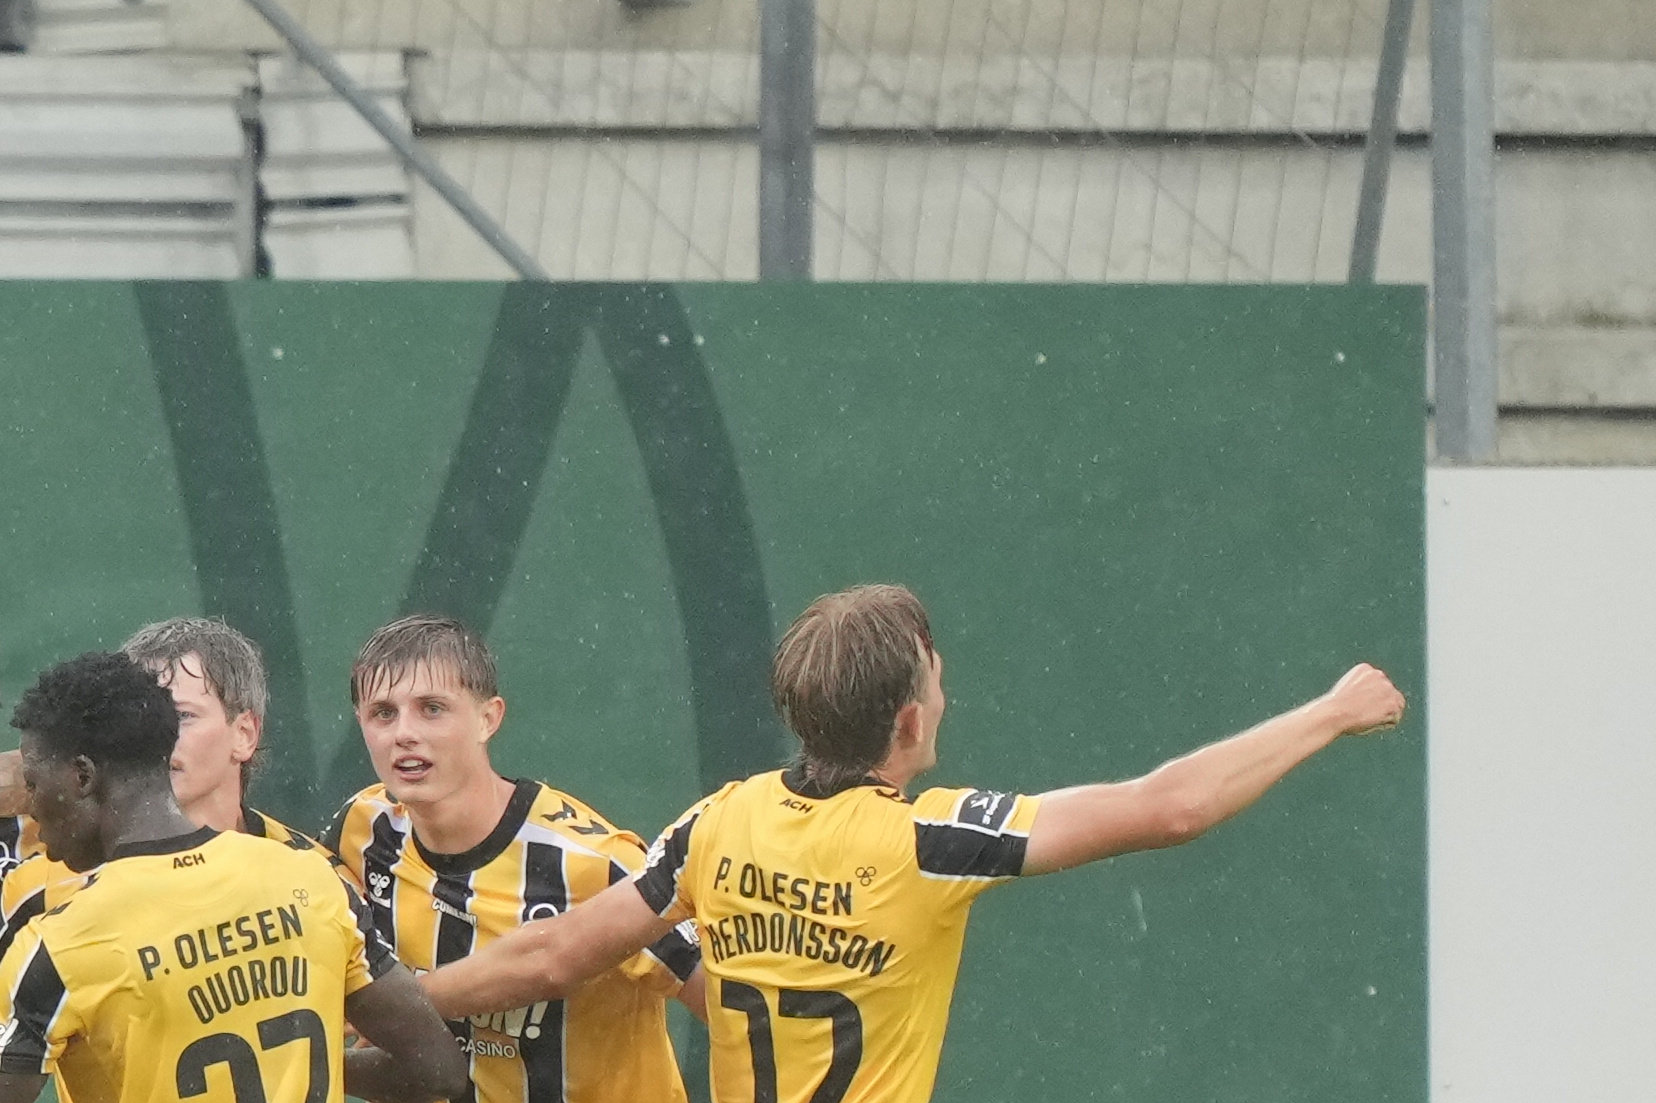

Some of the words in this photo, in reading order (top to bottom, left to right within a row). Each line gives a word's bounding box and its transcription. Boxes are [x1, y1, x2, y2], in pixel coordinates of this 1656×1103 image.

[779, 798, 814, 814] ACH
[172, 853, 206, 869] ACH
[714, 856, 731, 893] P.
[739, 863, 852, 916] OLESEN
[137, 945, 170, 982] P.
[174, 904, 303, 970] OLESEN
[705, 912, 896, 977] HERDONSSON
[187, 956, 308, 1024] OUOROU
[455, 1036, 516, 1060] CASINO
